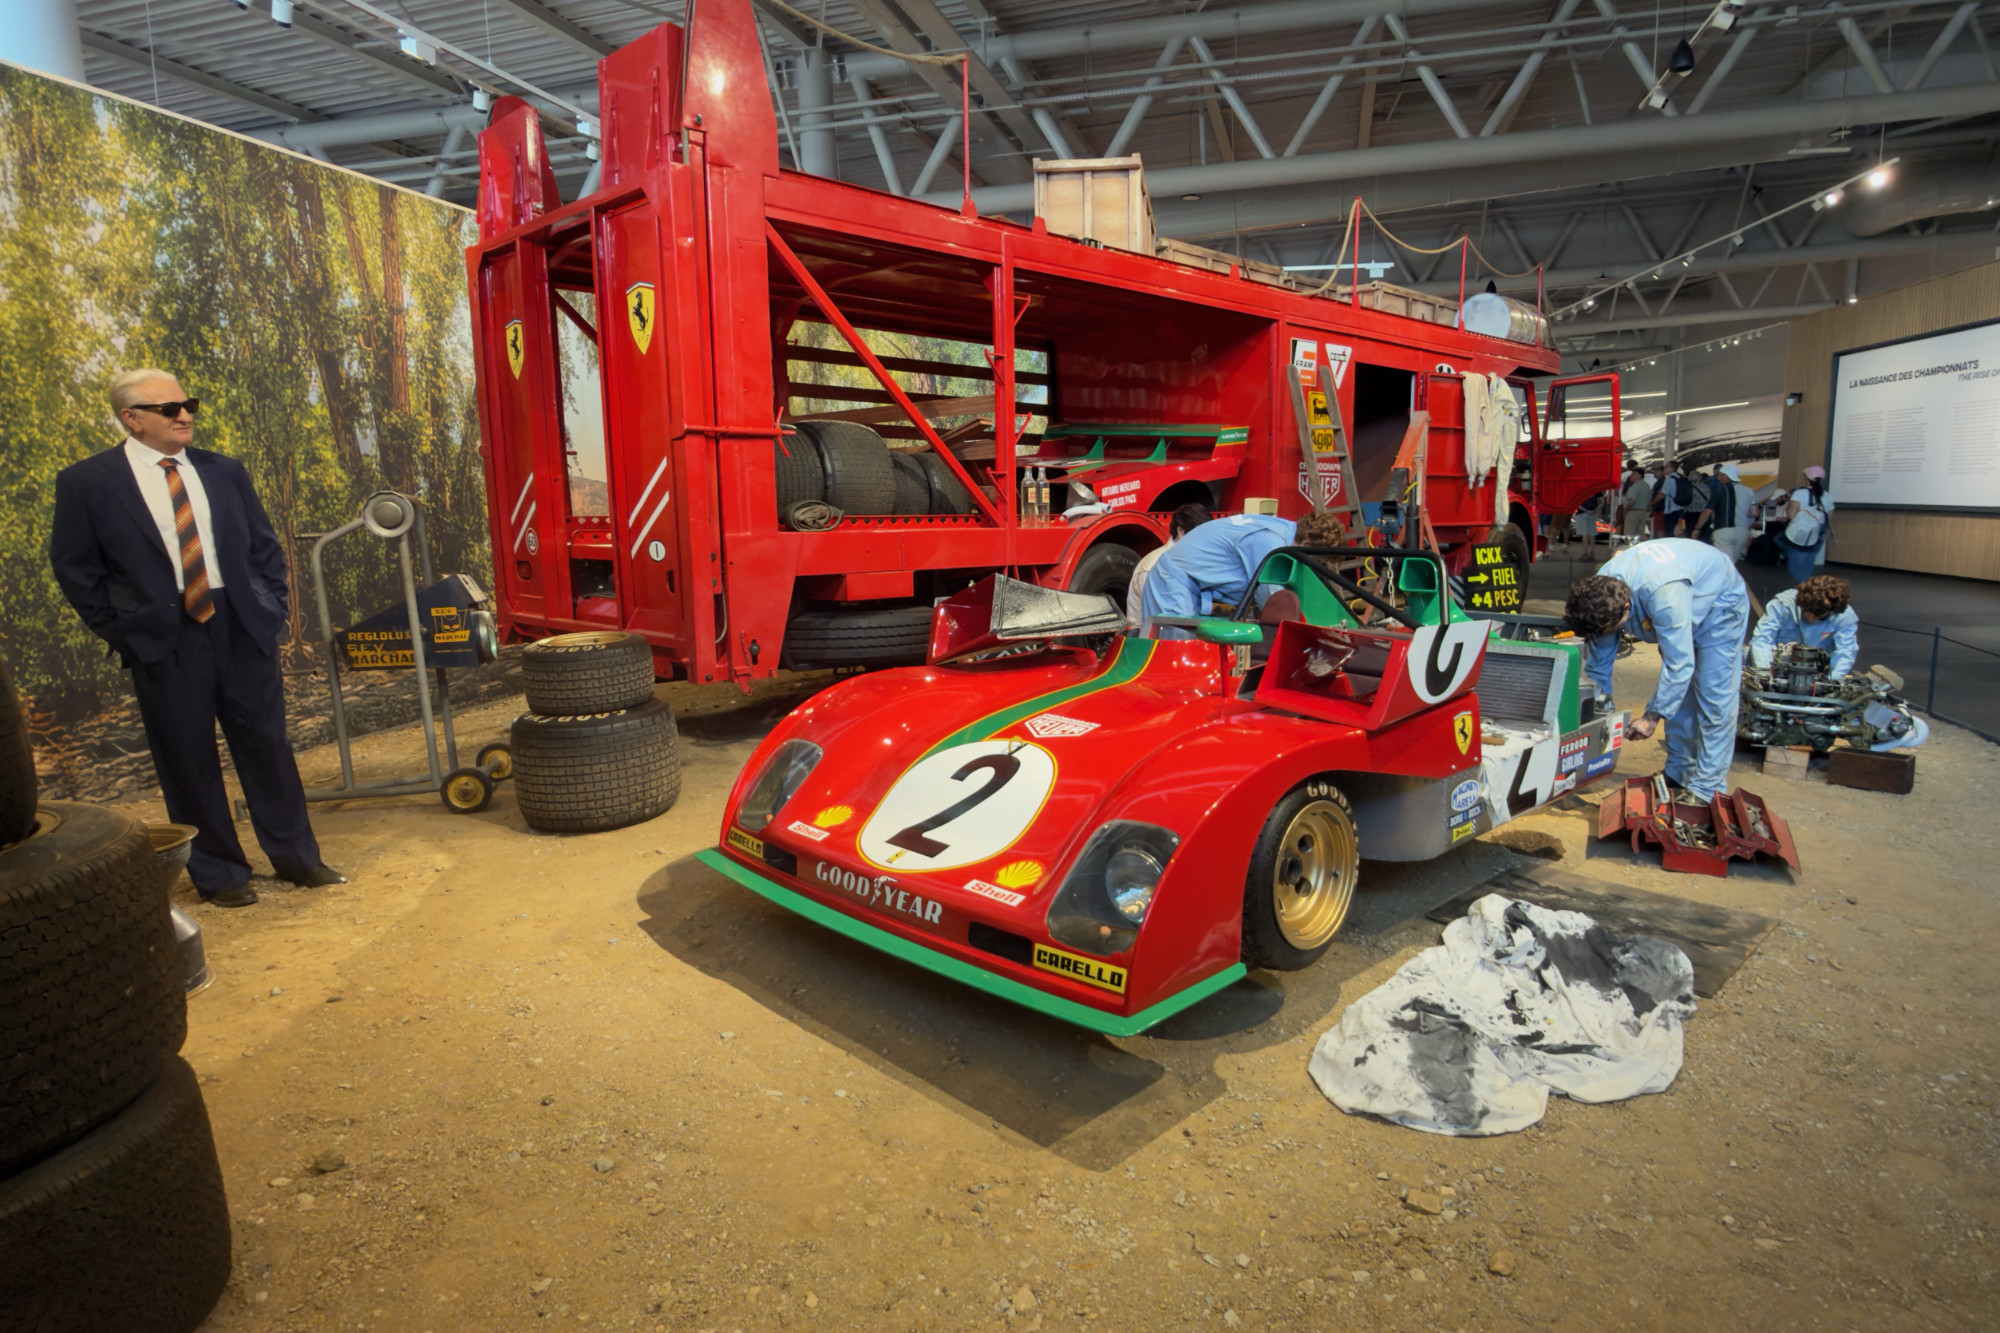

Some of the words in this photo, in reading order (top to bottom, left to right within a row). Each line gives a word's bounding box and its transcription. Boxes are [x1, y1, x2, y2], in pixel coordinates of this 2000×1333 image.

[1295, 360, 1314, 369] FRAM
[1849, 380, 1858, 389] LA
[1859, 373, 1898, 387] NAISSANCE
[1898, 370, 1913, 381] DES
[1914, 360, 1979, 378] CHAMPIONNATS
[1957, 372, 1972, 382] THE
[1972, 370, 1991, 380] RISE
[1101, 484, 1119, 497] ARTURO
[1119, 480, 1141, 492] MERZARIO
[1125, 493, 1137, 504] PACE
[1475, 546, 1502, 565] ICKX
[1491, 567, 1517, 586] FUEL
[1494, 589, 1520, 607] PESC
[1030, 718, 1087, 735] HEUER
[1560, 736, 1589, 756] FERODO
[1561, 751, 1584, 773] GIRLING
[885, 754, 1021, 859] 2
[1450, 813, 1464, 827] BORG
[793, 824, 825, 840] Shell
[729, 830, 762, 854] CARELLO
[971, 882, 1019, 904] Shell
[1036, 948, 1123, 988] CARELLO
